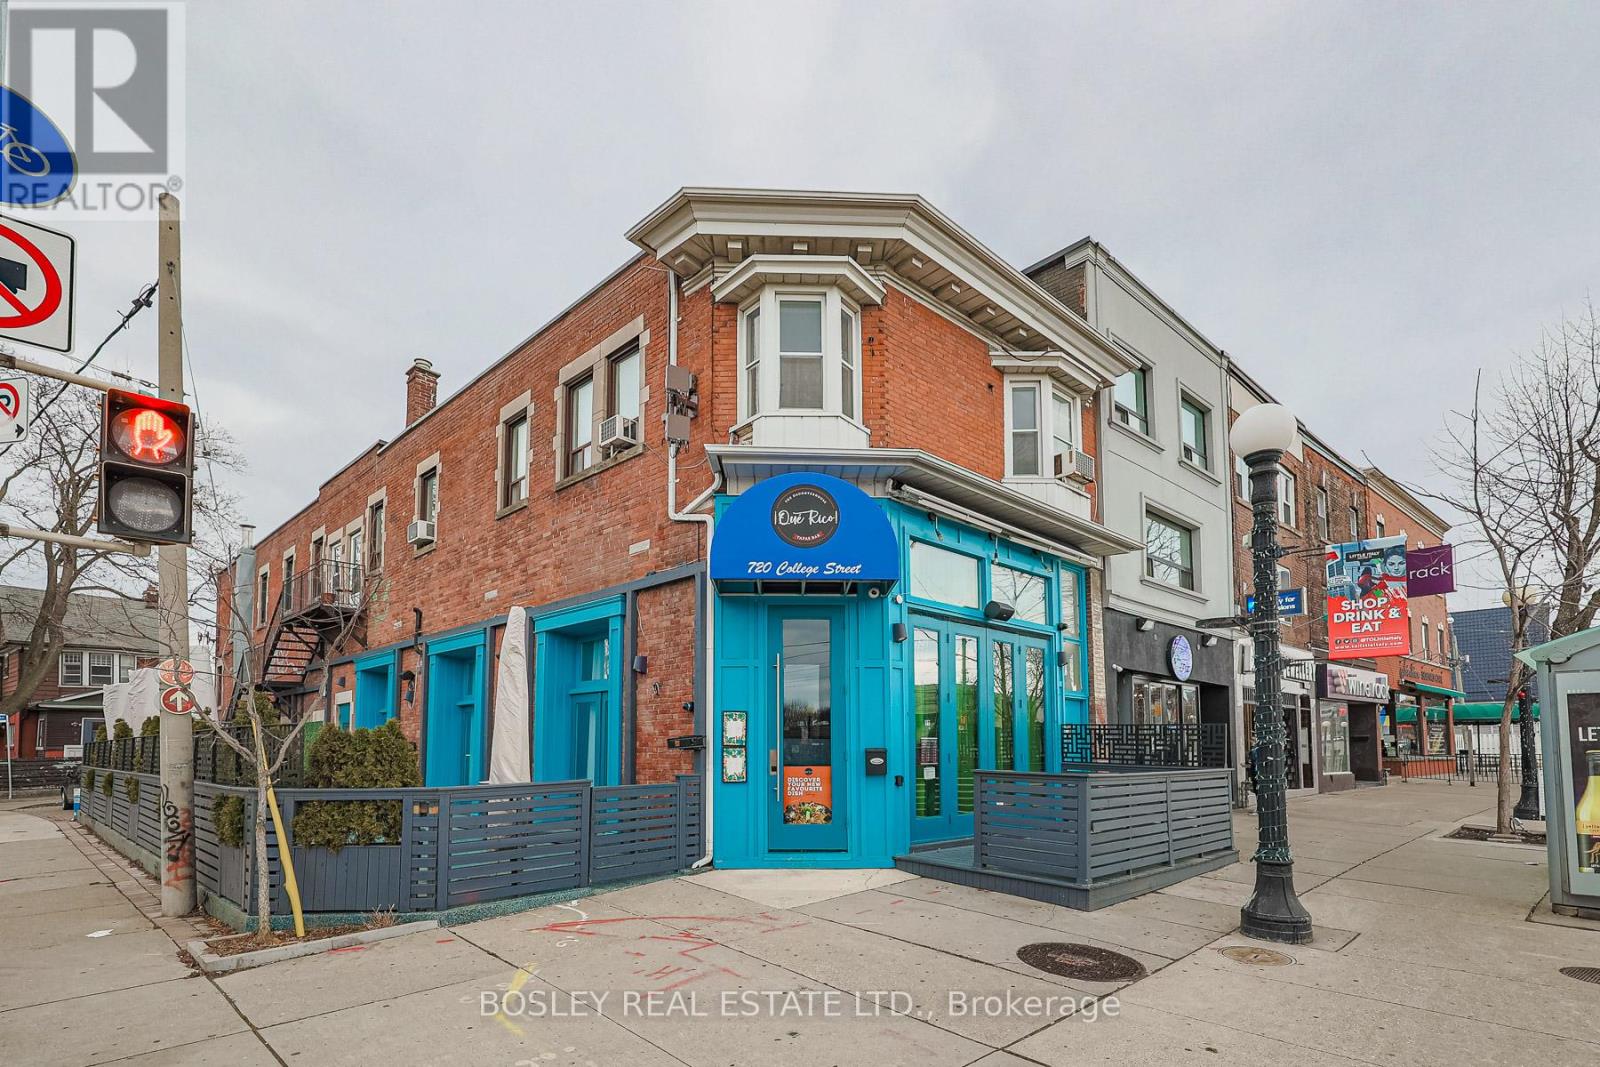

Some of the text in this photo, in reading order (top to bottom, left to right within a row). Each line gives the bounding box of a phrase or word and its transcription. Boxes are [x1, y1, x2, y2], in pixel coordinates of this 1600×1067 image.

[803, 509, 834, 526] Rico
[748, 561, 862, 578] 720 College Street
[1409, 561, 1450, 580] rack
[1341, 597, 1391, 611] SHOP,
[1333, 607, 1401, 624] DRINK &
[1351, 621, 1382, 633] EAT
